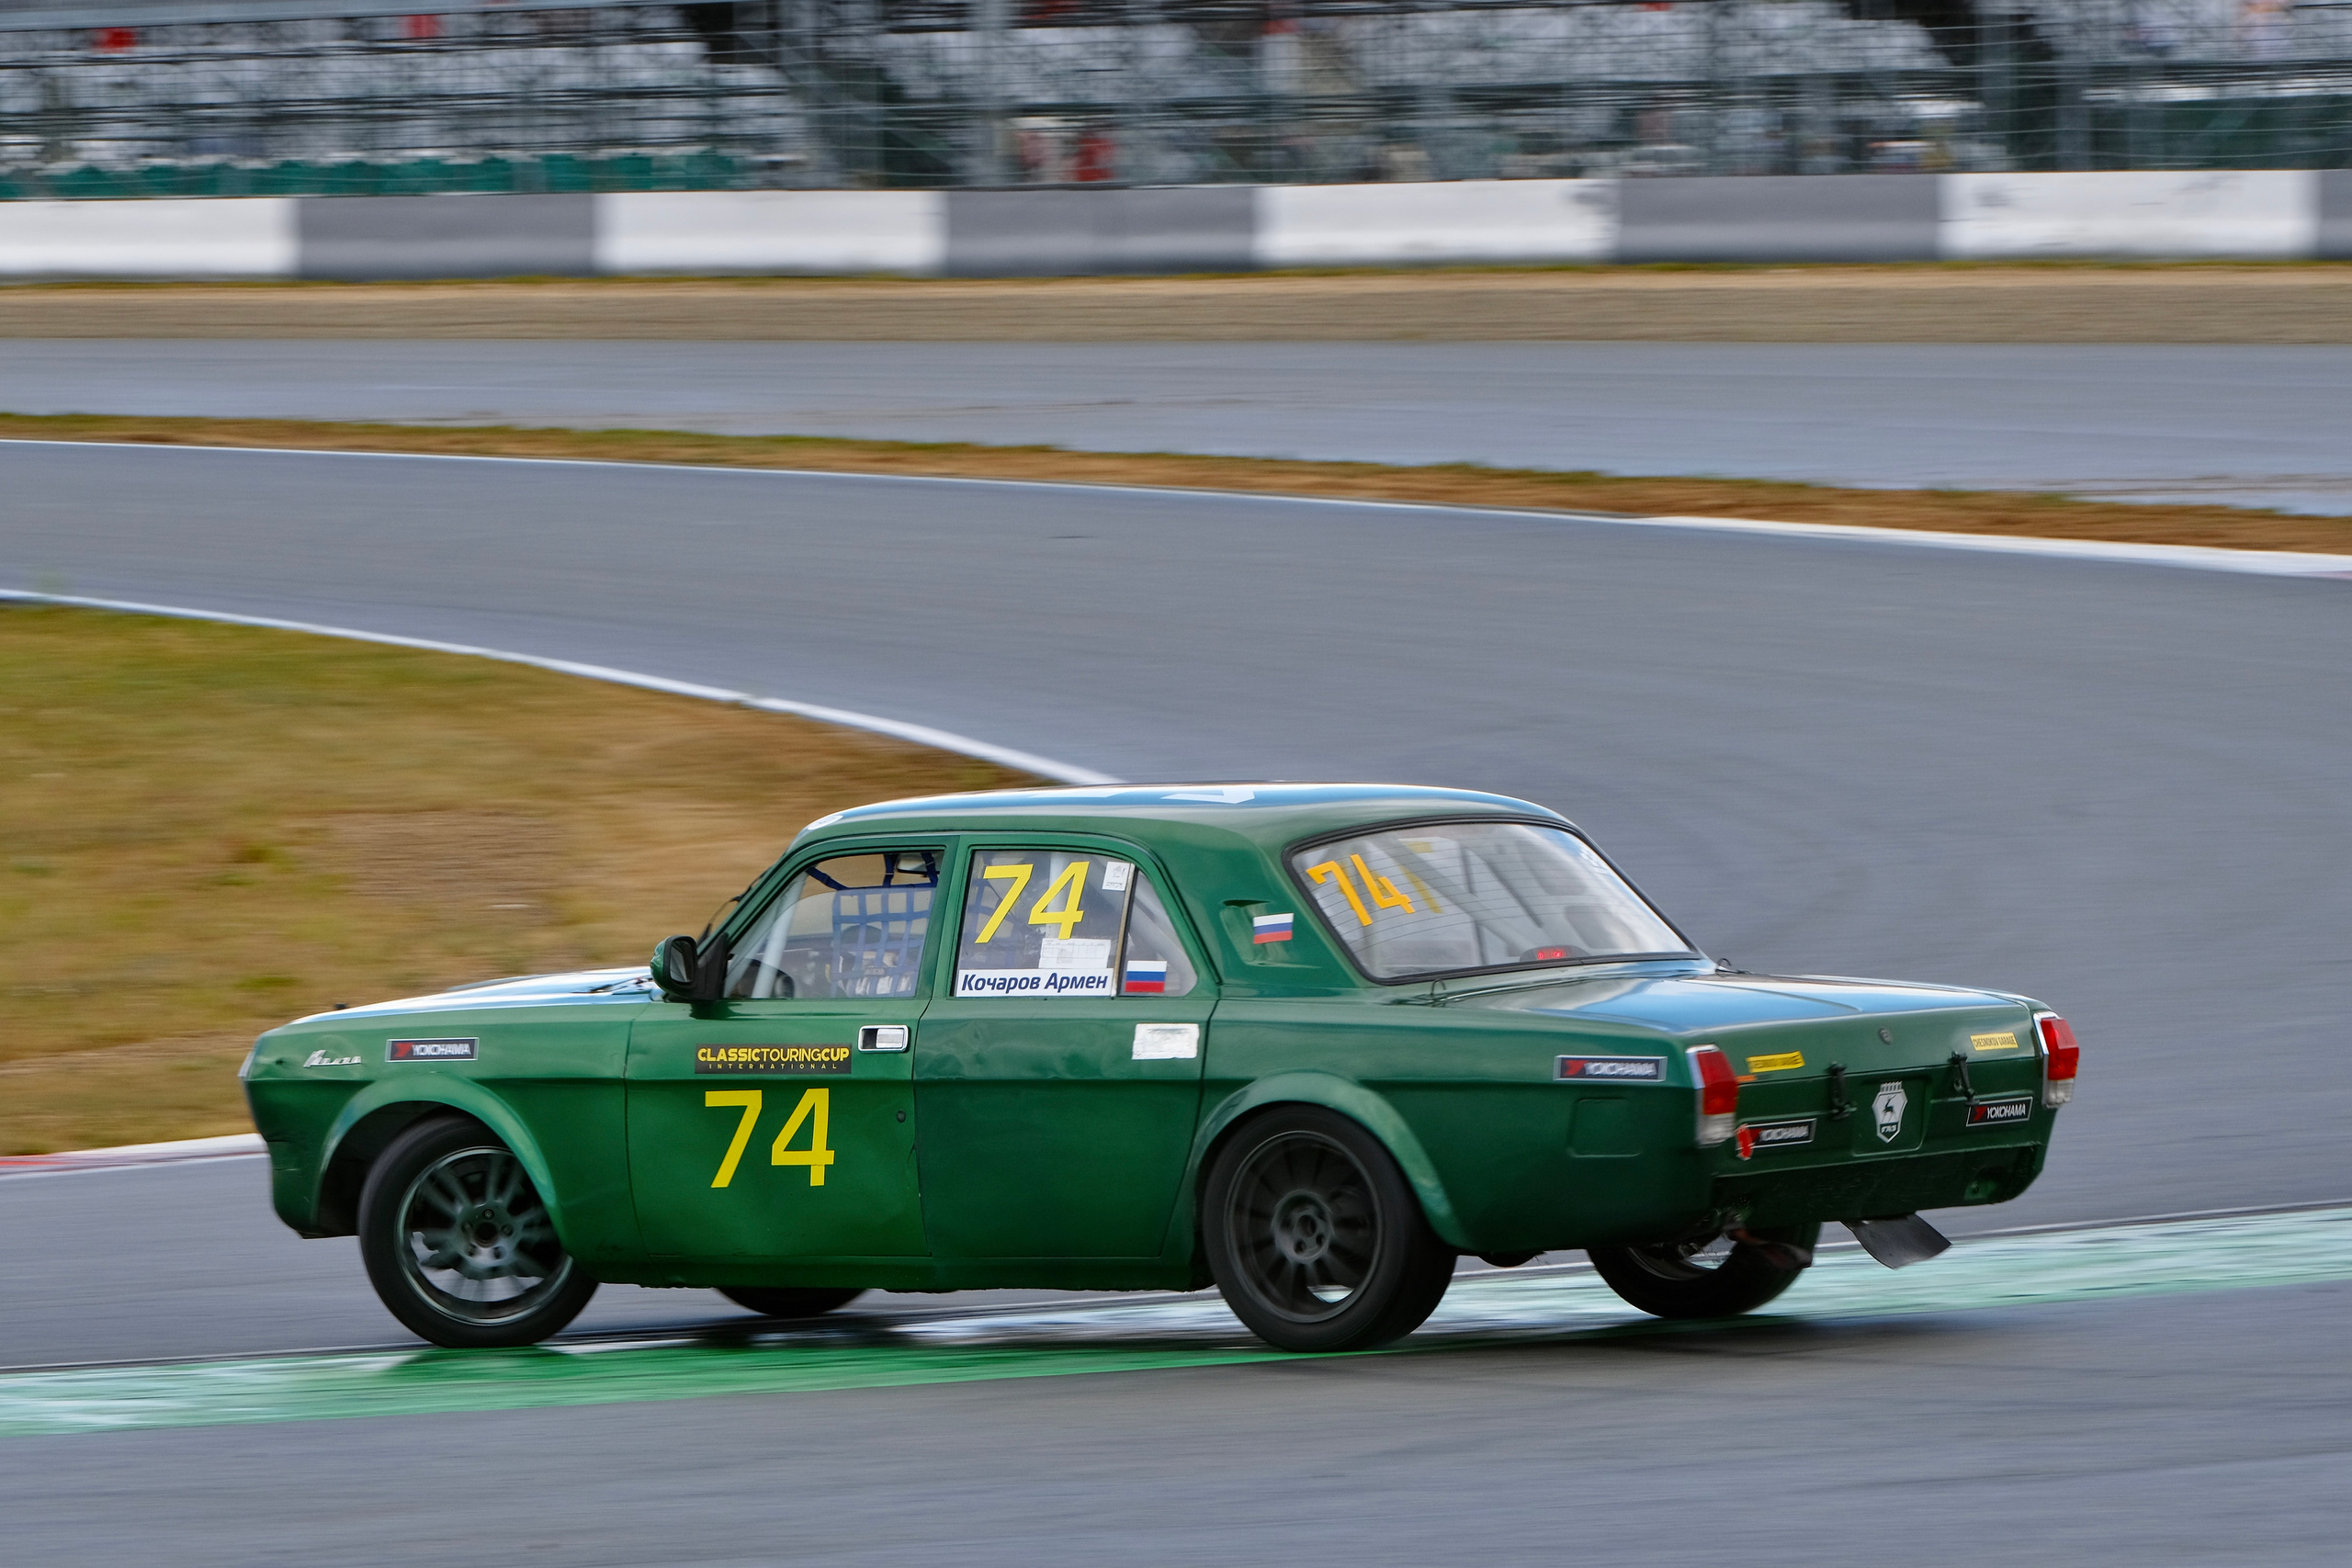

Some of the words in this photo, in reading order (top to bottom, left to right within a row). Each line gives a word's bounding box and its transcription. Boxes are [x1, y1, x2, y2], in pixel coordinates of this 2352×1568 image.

[974, 861, 1091, 944] 74
[1306, 853, 1416, 927] 74
[961, 974, 1040, 994] Кочаров
[1045, 972, 1108, 993] Армен
[705, 1088, 835, 1189] 74
[1985, 1103, 2027, 1120] YOKOHAMA
